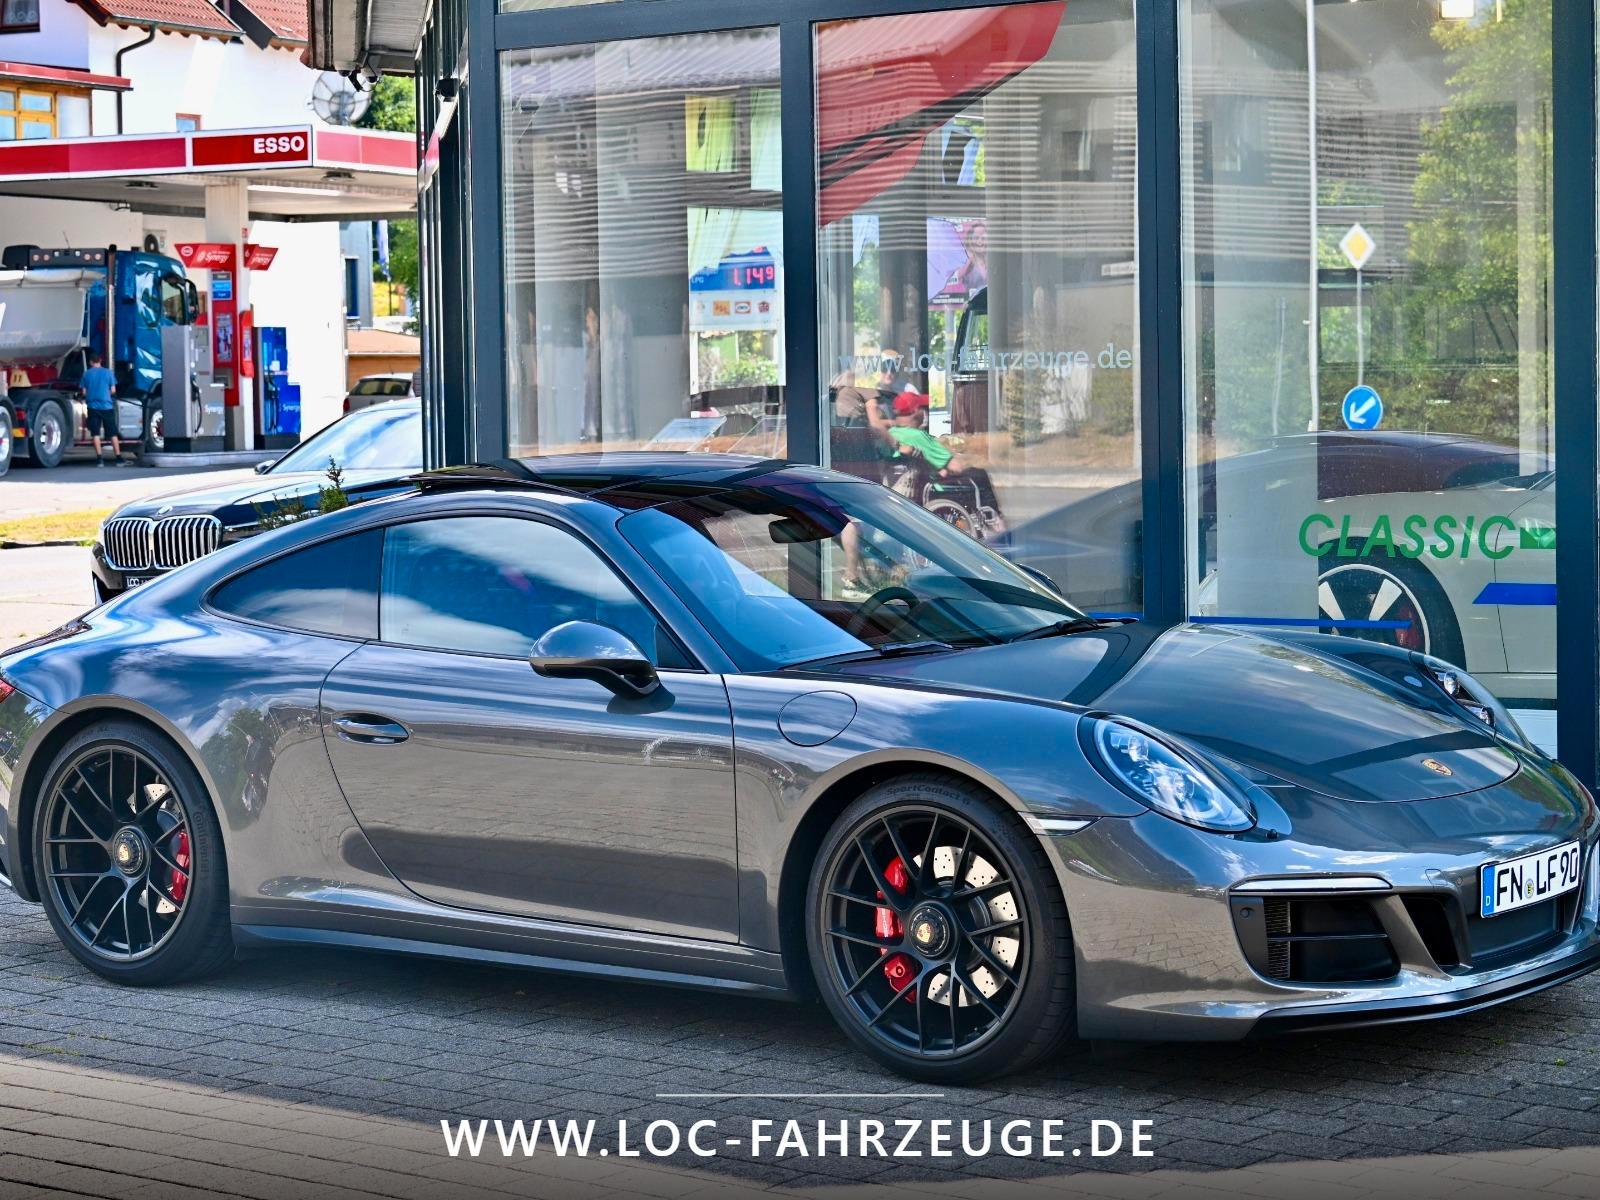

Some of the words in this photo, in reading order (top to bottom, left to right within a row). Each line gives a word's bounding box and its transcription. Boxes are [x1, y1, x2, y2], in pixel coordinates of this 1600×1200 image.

[253, 135, 305, 154] ESSO
[838, 342, 1133, 375] www.loc-fahrzeuge.de
[1298, 513, 1517, 560] CLASSIC
[1496, 864, 1524, 907] FN
[1536, 854, 1558, 896] LF
[1560, 847, 1579, 887] 90
[1485, 895, 1491, 907] D
